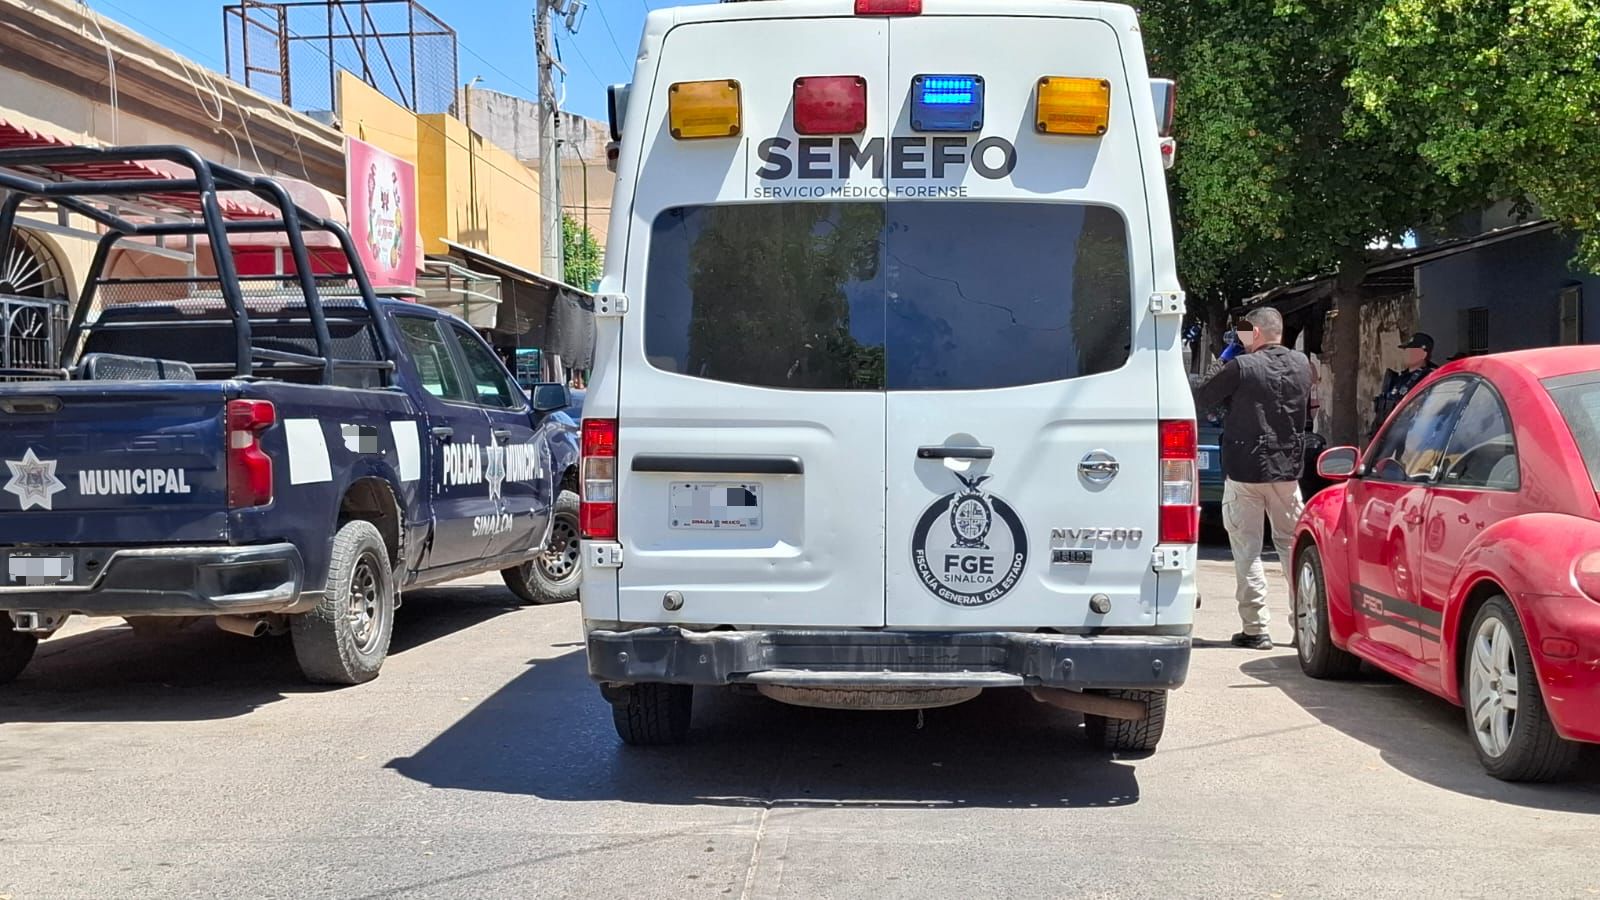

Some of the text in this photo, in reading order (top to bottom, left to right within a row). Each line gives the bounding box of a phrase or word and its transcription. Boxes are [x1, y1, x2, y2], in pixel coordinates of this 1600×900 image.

[755, 136, 1017, 180] SEMEFO
[753, 183, 967, 198] SERVICIO MÉDICO FORENSE
[443, 434, 482, 486] POLICÍA
[79, 468, 191, 495] MUNICIPAL
[472, 513, 513, 537] SINALOA
[1049, 527, 1143, 542] NV2500
[915, 549, 1024, 604] FISCALÍA GENERAL DEL ESTADO
[944, 554, 994, 575] FGE
[944, 573, 993, 584] SINALOA
